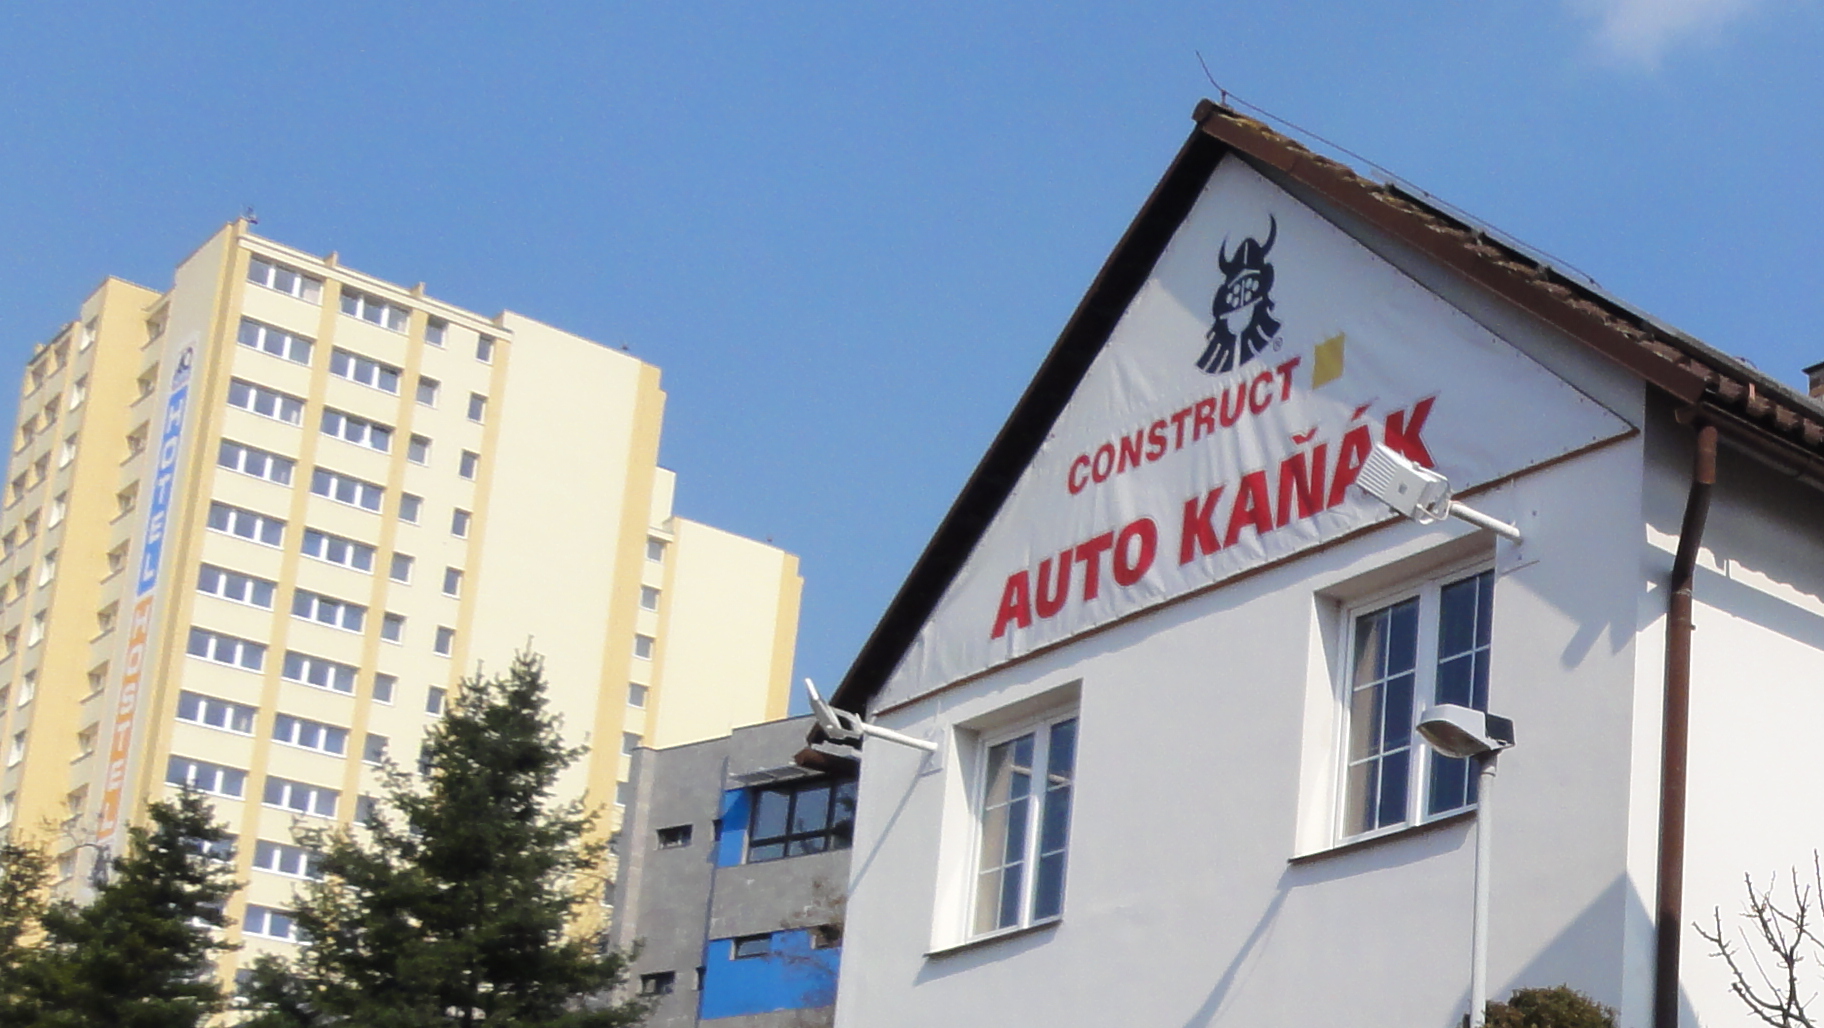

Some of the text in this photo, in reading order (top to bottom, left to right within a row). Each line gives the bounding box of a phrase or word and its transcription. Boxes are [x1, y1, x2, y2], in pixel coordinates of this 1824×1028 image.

[143, 397, 183, 582] HOTEL
[1066, 356, 1301, 495] CONSTRUCT
[990, 517, 1158, 640] AUTO
[101, 606, 152, 835] HOSTEL
